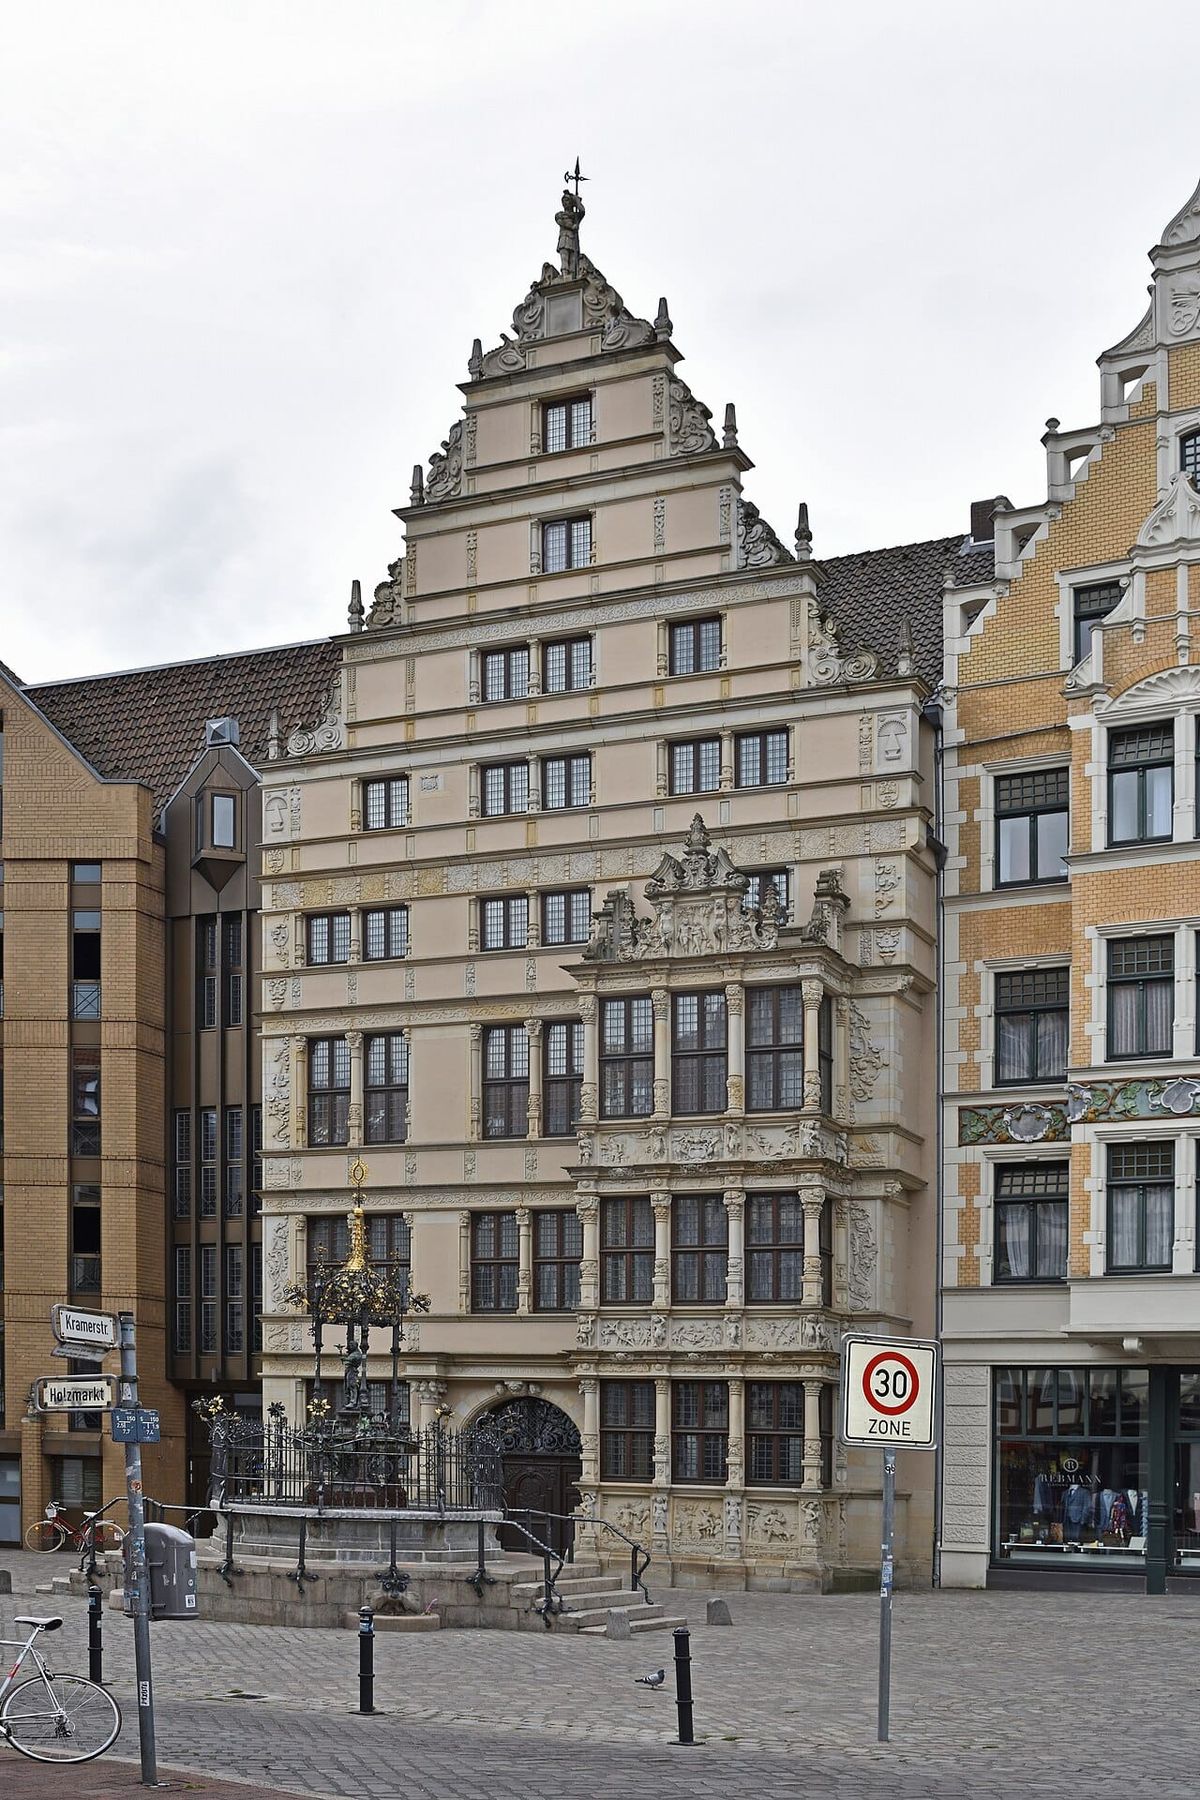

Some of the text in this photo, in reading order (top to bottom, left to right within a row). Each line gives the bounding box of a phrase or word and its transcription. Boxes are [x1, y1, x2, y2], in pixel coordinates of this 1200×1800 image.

[65, 1314, 109, 1336] Kramerstr.
[875, 1369, 907, 1399] 30
[50, 1387, 104, 1402] Holzmarkt
[868, 1418, 911, 1437] ZONE
